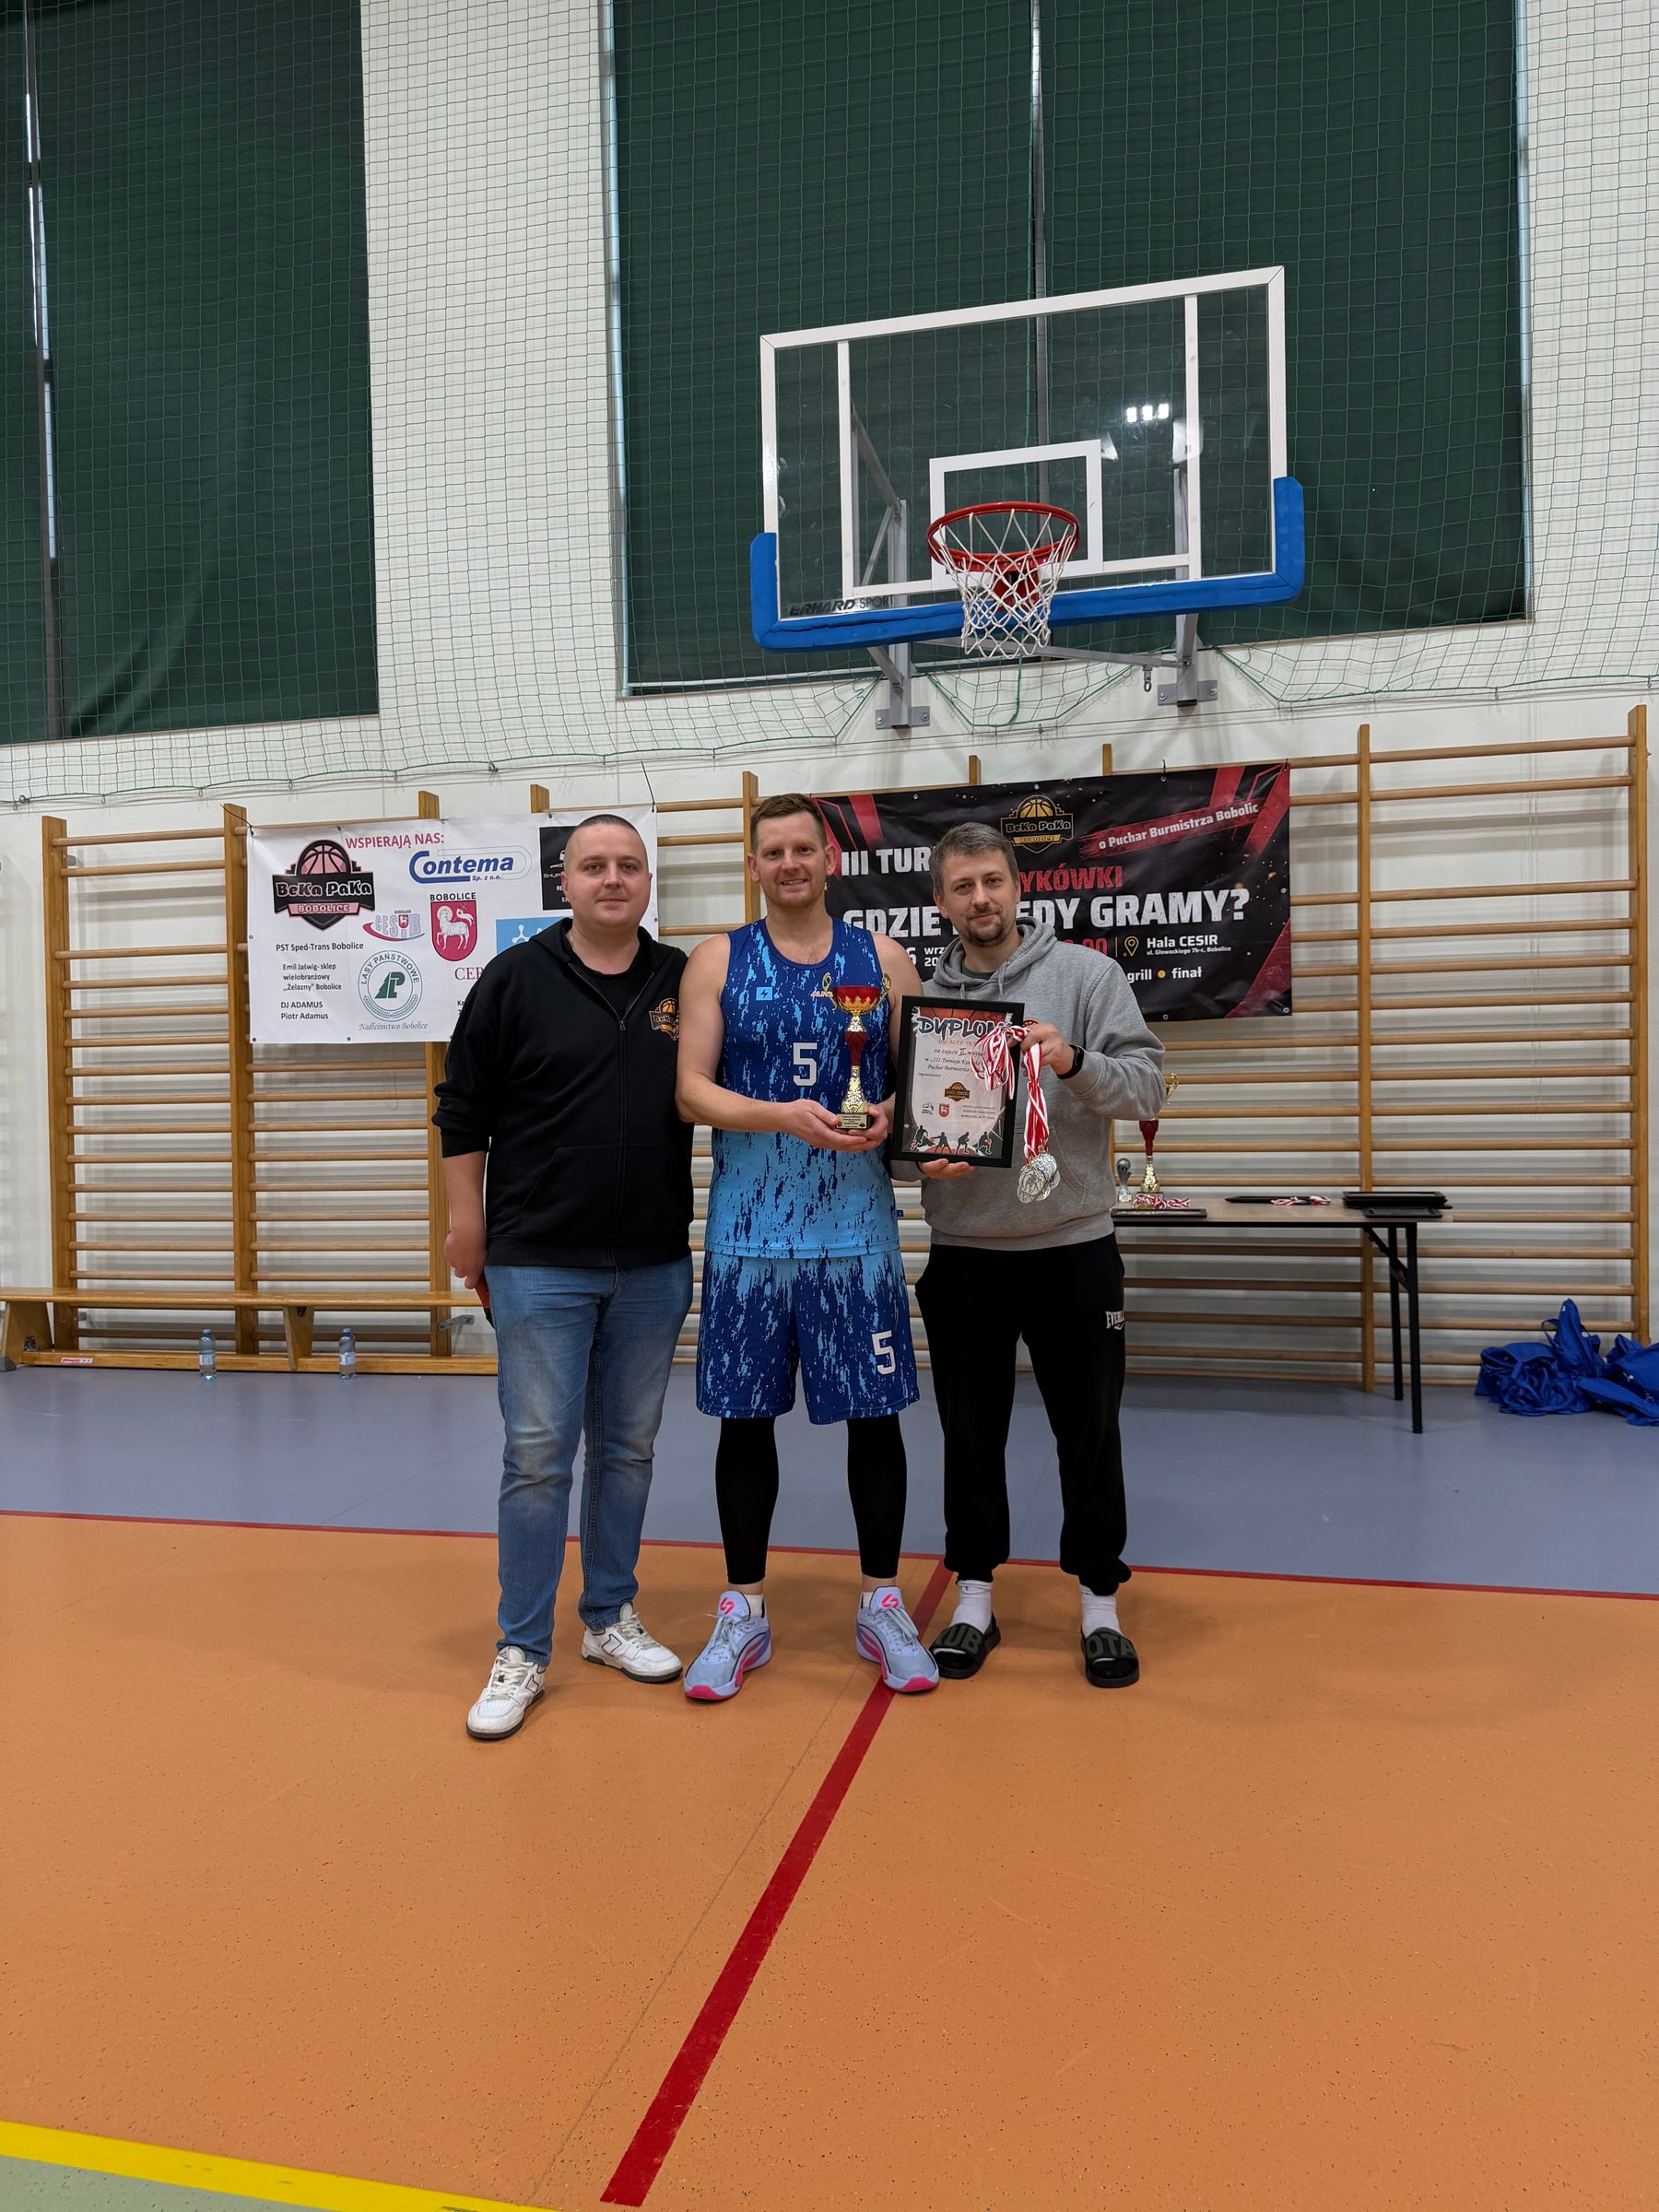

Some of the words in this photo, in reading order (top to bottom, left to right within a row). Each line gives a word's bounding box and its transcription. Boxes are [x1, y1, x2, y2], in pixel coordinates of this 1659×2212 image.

[789, 599, 856, 617] ERHARD
[859, 594, 895, 609] SPORT
[1006, 822, 1037, 833] BeKa
[1039, 819, 1071, 831] PaKa
[1099, 841, 1107, 850] o
[1108, 831, 1147, 847] Puchar
[1149, 816, 1214, 838] Burmistrza
[1215, 803, 1259, 821] Bobolic
[346, 834, 411, 850] WSPIERAJĄ
[415, 832, 444, 845] NAS:
[409, 851, 513, 884] Contema
[841, 850, 869, 876] III
[876, 846, 936, 874] TUR
[1018, 863, 1123, 893] YKÓWKI
[276, 882, 323, 897] BeKa
[326, 880, 372, 896] PaKa
[429, 892, 477, 901] BOBOLICE
[298, 904, 350, 912] BOBOLICE
[1090, 888, 1250, 928] GRAMY?
[291, 943, 330, 953] Sped-Trans
[332, 942, 364, 950] Bobolice
[1147, 936, 1176, 948] Hala
[1180, 935, 1218, 947] CESIR
[924, 947, 947, 956] wrz
[320, 962, 336, 971] sklep
[361, 961, 374, 984] LASY
[373, 952, 419, 983] PAŃSTWOWE
[924, 957, 938, 967] 20
[1127, 969, 1152, 983] grill
[1171, 966, 1202, 979] finał
[793, 1042, 818, 1087] 5
[871, 1330, 896, 1375] 5
